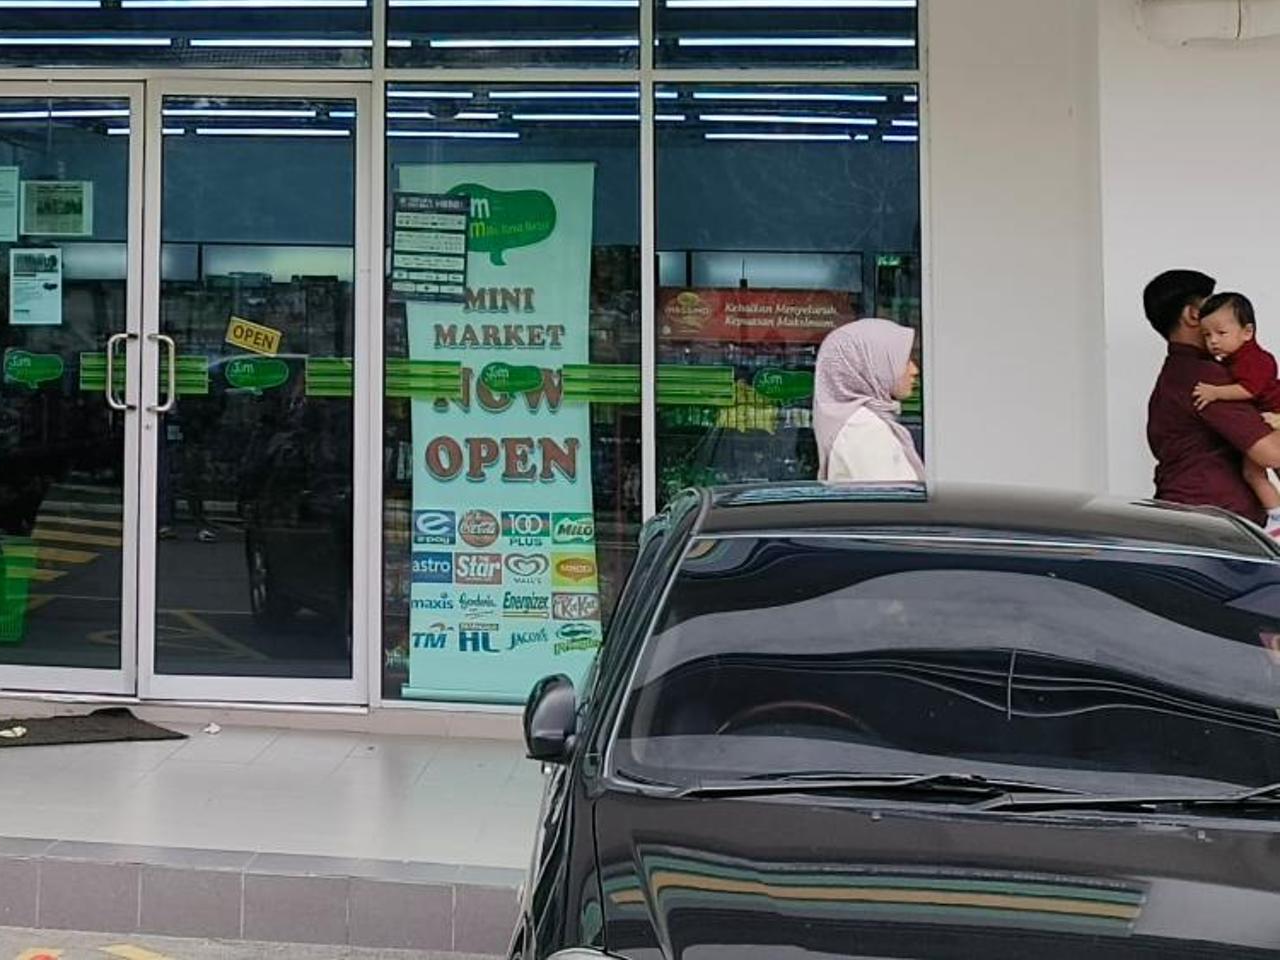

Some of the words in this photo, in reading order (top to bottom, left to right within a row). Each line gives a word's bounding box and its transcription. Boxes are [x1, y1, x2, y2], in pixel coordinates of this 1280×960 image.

[462, 287, 535, 313] MINI
[233, 325, 274, 349] OPEN
[433, 323, 565, 350] MARKET
[425, 435, 580, 483] OPEN
[508, 513, 542, 535] 100
[557, 524, 593, 536] MILO
[509, 538, 542, 546] PLUS
[412, 559, 451, 572] astro
[457, 554, 500, 577] Star
[412, 593, 454, 609] maxis
[503, 591, 549, 609] Energizer
[412, 632, 447, 649] TM
[459, 631, 500, 652] HL
